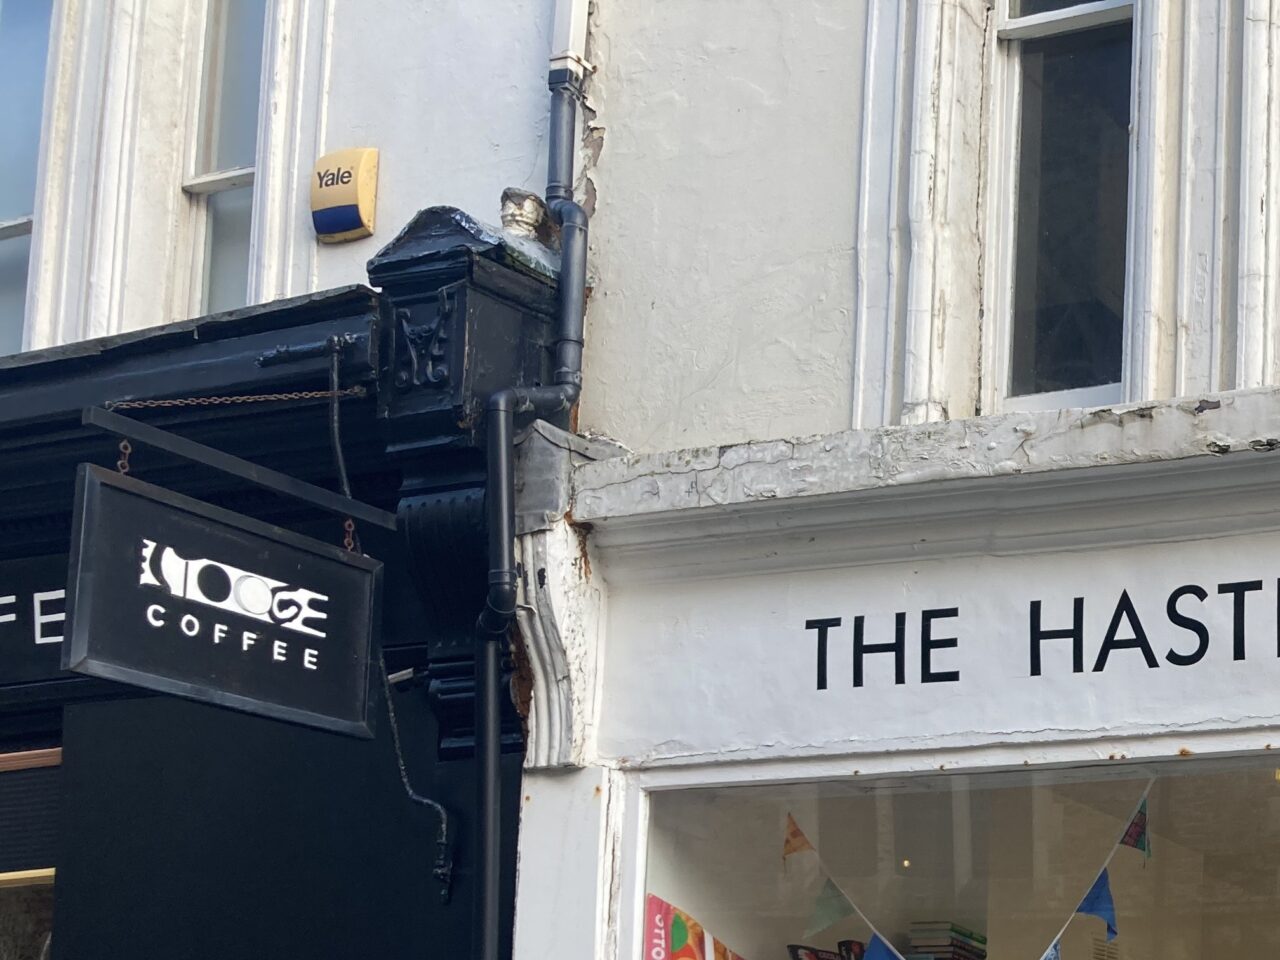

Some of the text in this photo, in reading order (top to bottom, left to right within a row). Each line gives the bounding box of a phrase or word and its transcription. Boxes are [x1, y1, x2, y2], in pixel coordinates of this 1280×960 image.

[317, 167, 352, 188] Yale
[146, 604, 319, 670] COFFEE
[804, 606, 961, 691] THE
